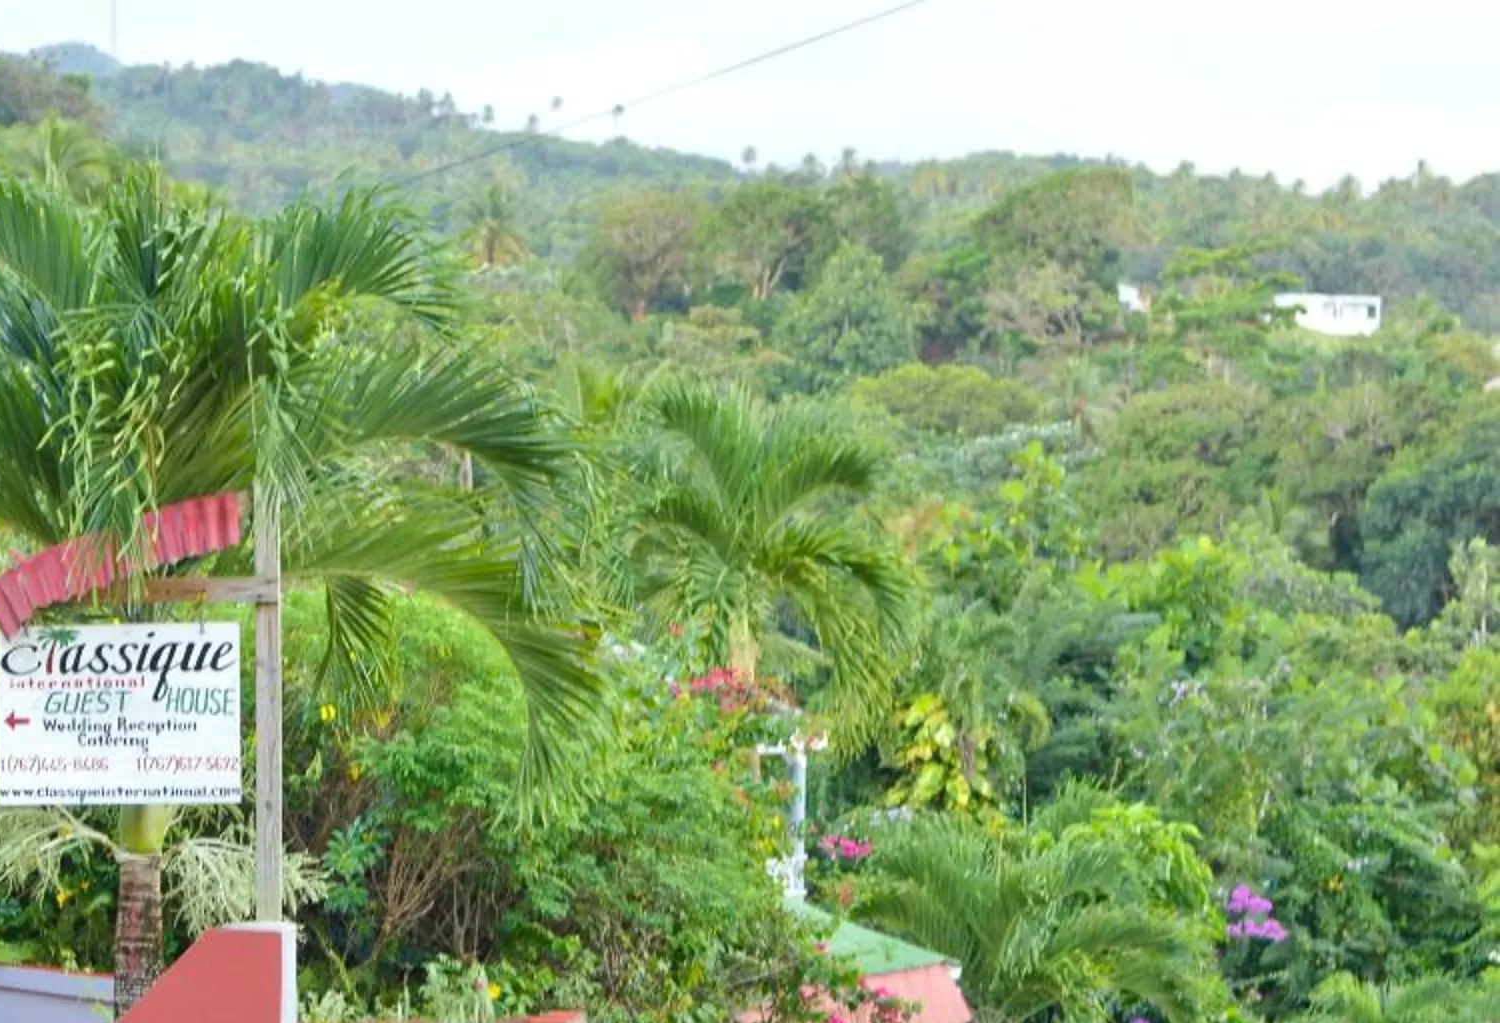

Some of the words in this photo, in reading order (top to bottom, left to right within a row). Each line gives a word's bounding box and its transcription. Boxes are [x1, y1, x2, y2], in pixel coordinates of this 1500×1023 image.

[0, 630, 237, 703] Classique
[9, 675, 146, 690] international
[43, 690, 132, 715] GUEST
[165, 687, 237, 716] HOUSE
[42, 718, 113, 735] Wedding
[117, 716, 198, 735] Reception
[77, 732, 150, 752] Catering
